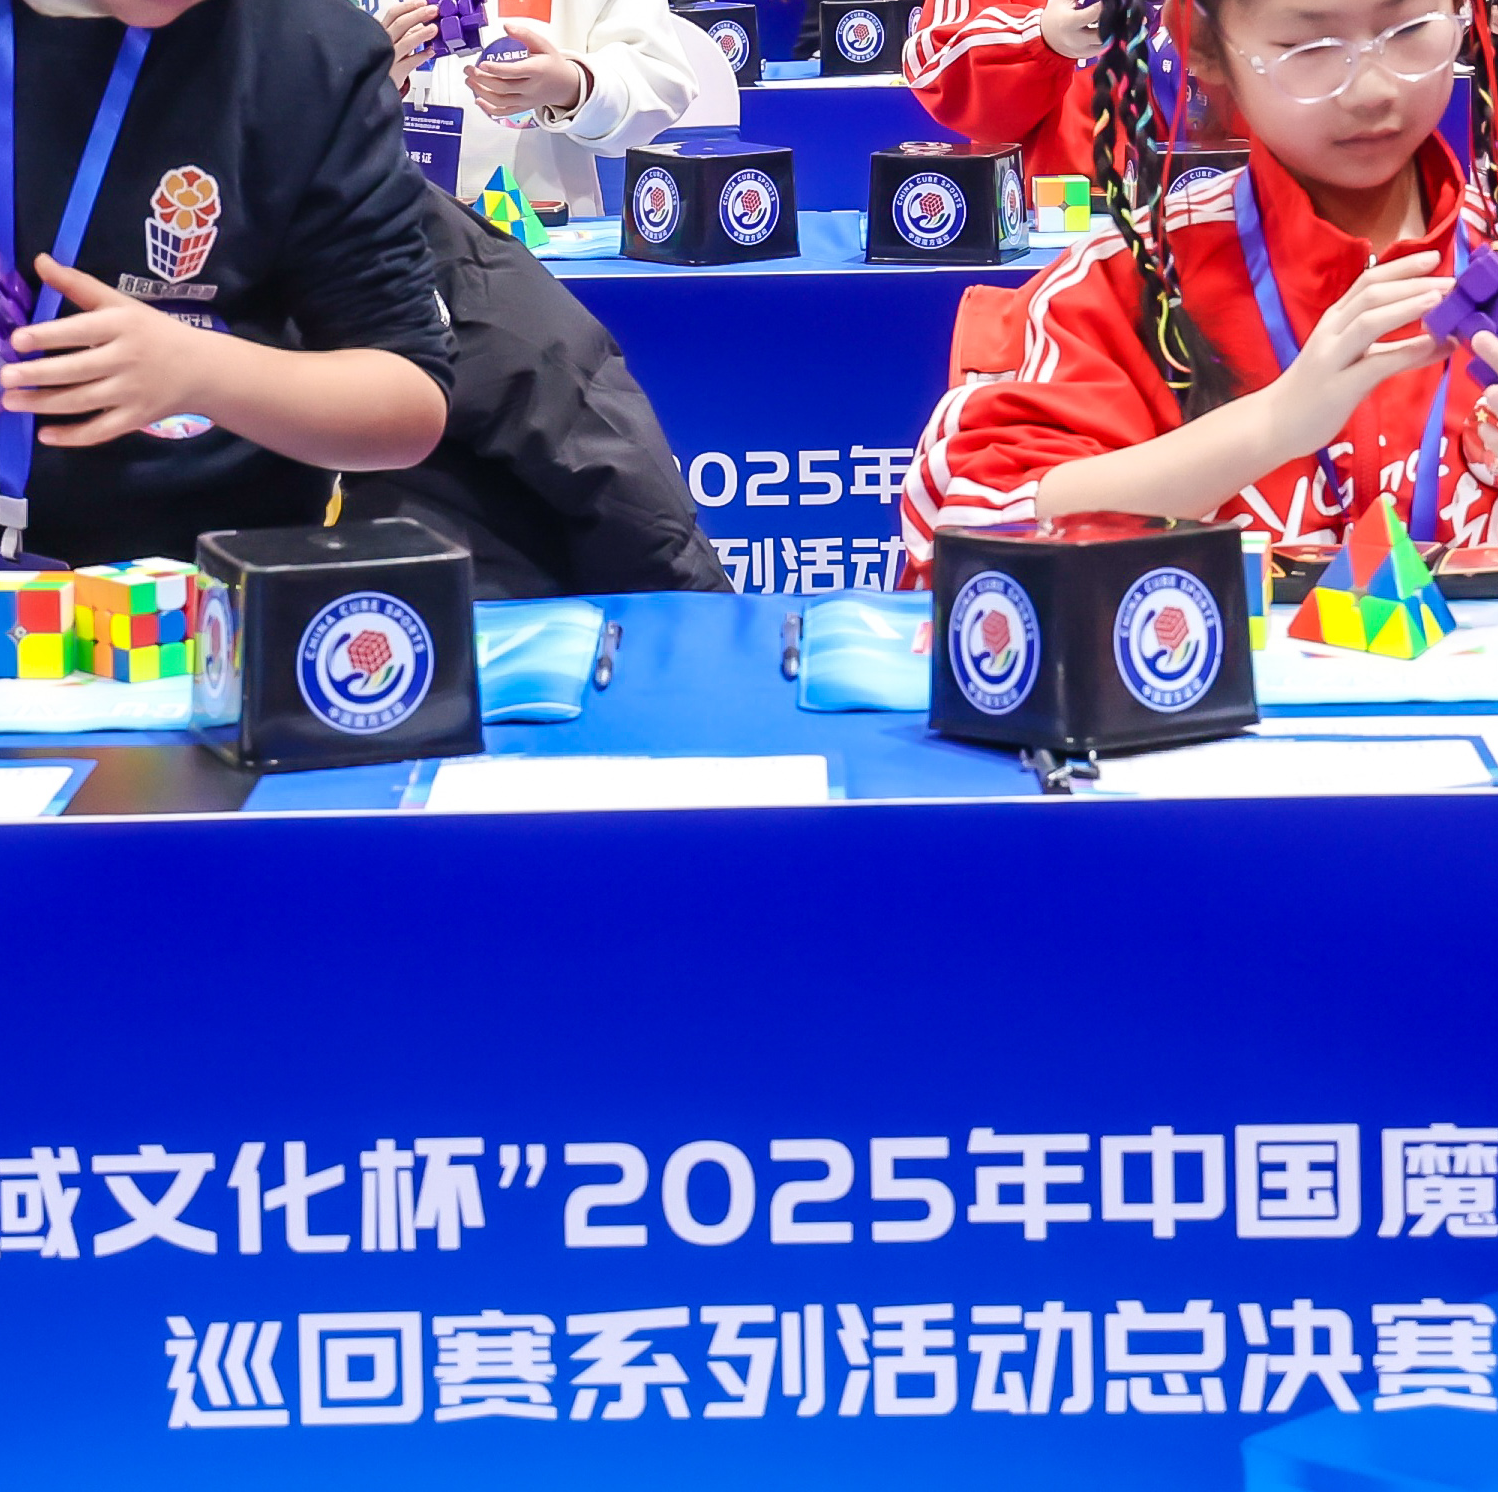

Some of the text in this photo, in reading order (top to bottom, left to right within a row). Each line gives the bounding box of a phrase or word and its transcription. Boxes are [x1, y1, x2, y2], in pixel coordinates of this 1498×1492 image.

[722, 179, 738, 206] CHINA
[756, 174, 776, 202] SPORTS
[1189, 170, 1213, 179] CUBE
[896, 181, 915, 207] CHINA
[940, 178, 964, 209] SPORTS
[674, 445, 914, 507] 025年
[165, 1299, 1498, 1430] 巡回赛系列活动总决赛
